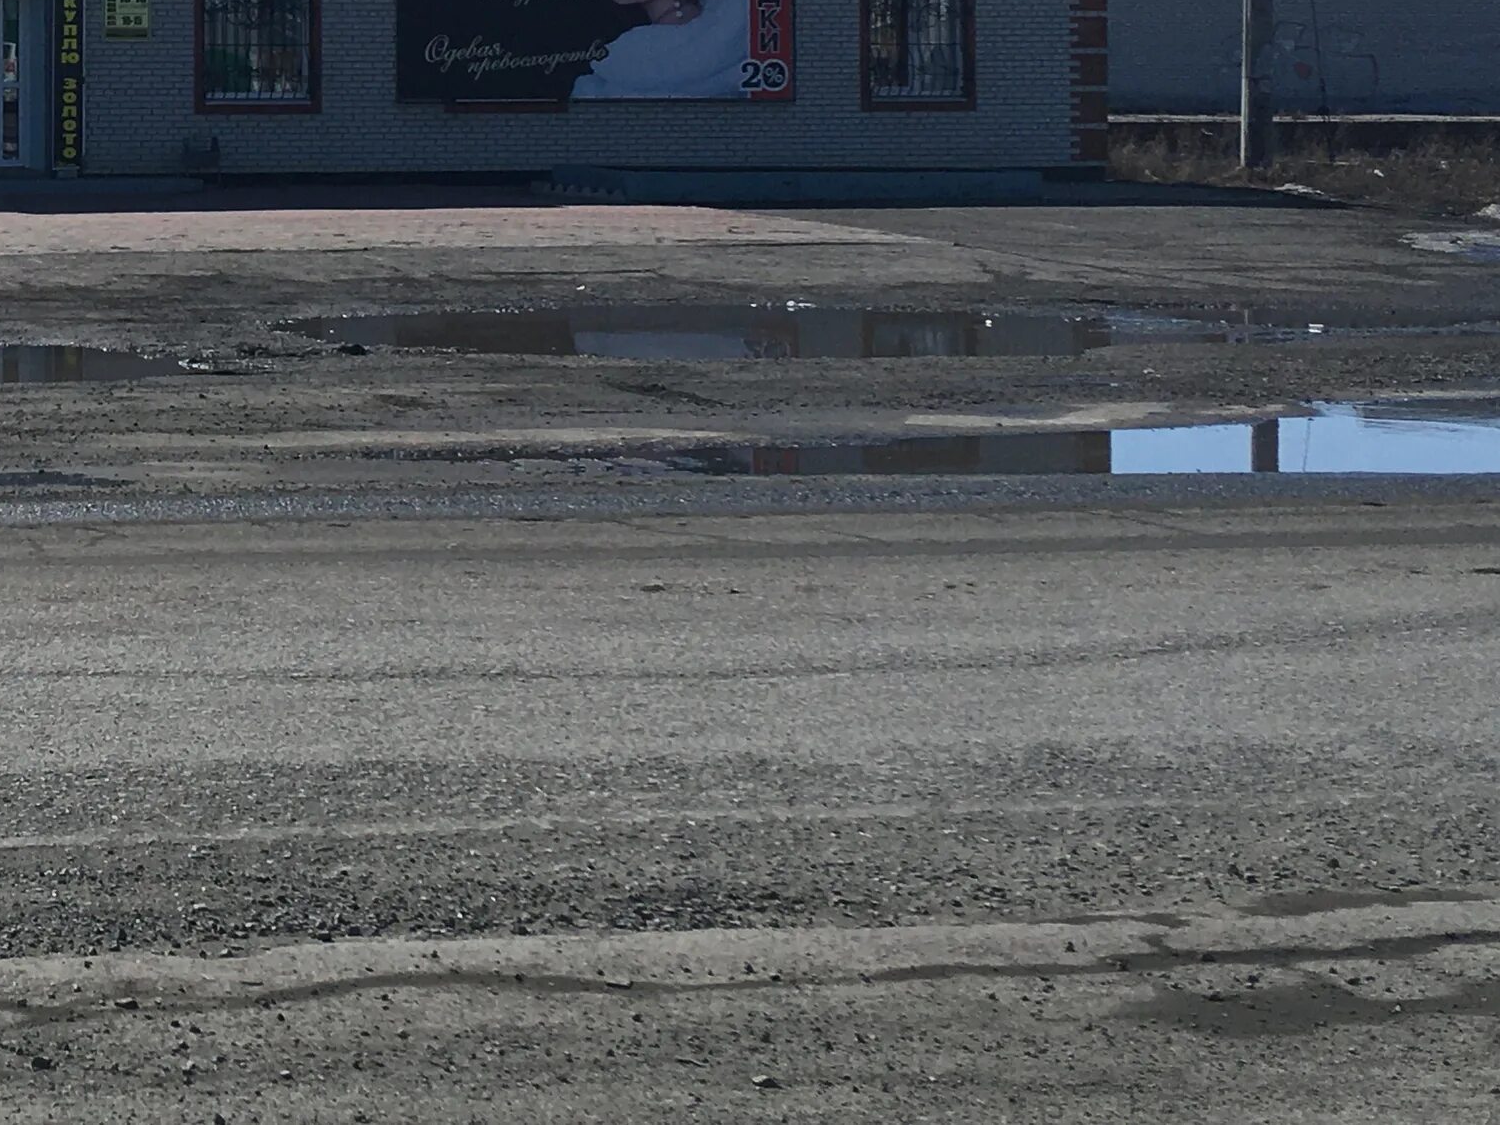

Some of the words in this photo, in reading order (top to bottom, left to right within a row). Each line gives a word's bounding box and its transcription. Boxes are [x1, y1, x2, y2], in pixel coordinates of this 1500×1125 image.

[424, 34, 501, 73] Одевая
[468, 38, 608, 81] превосходство
[62, 77, 78, 159] ЗОЛОТО
